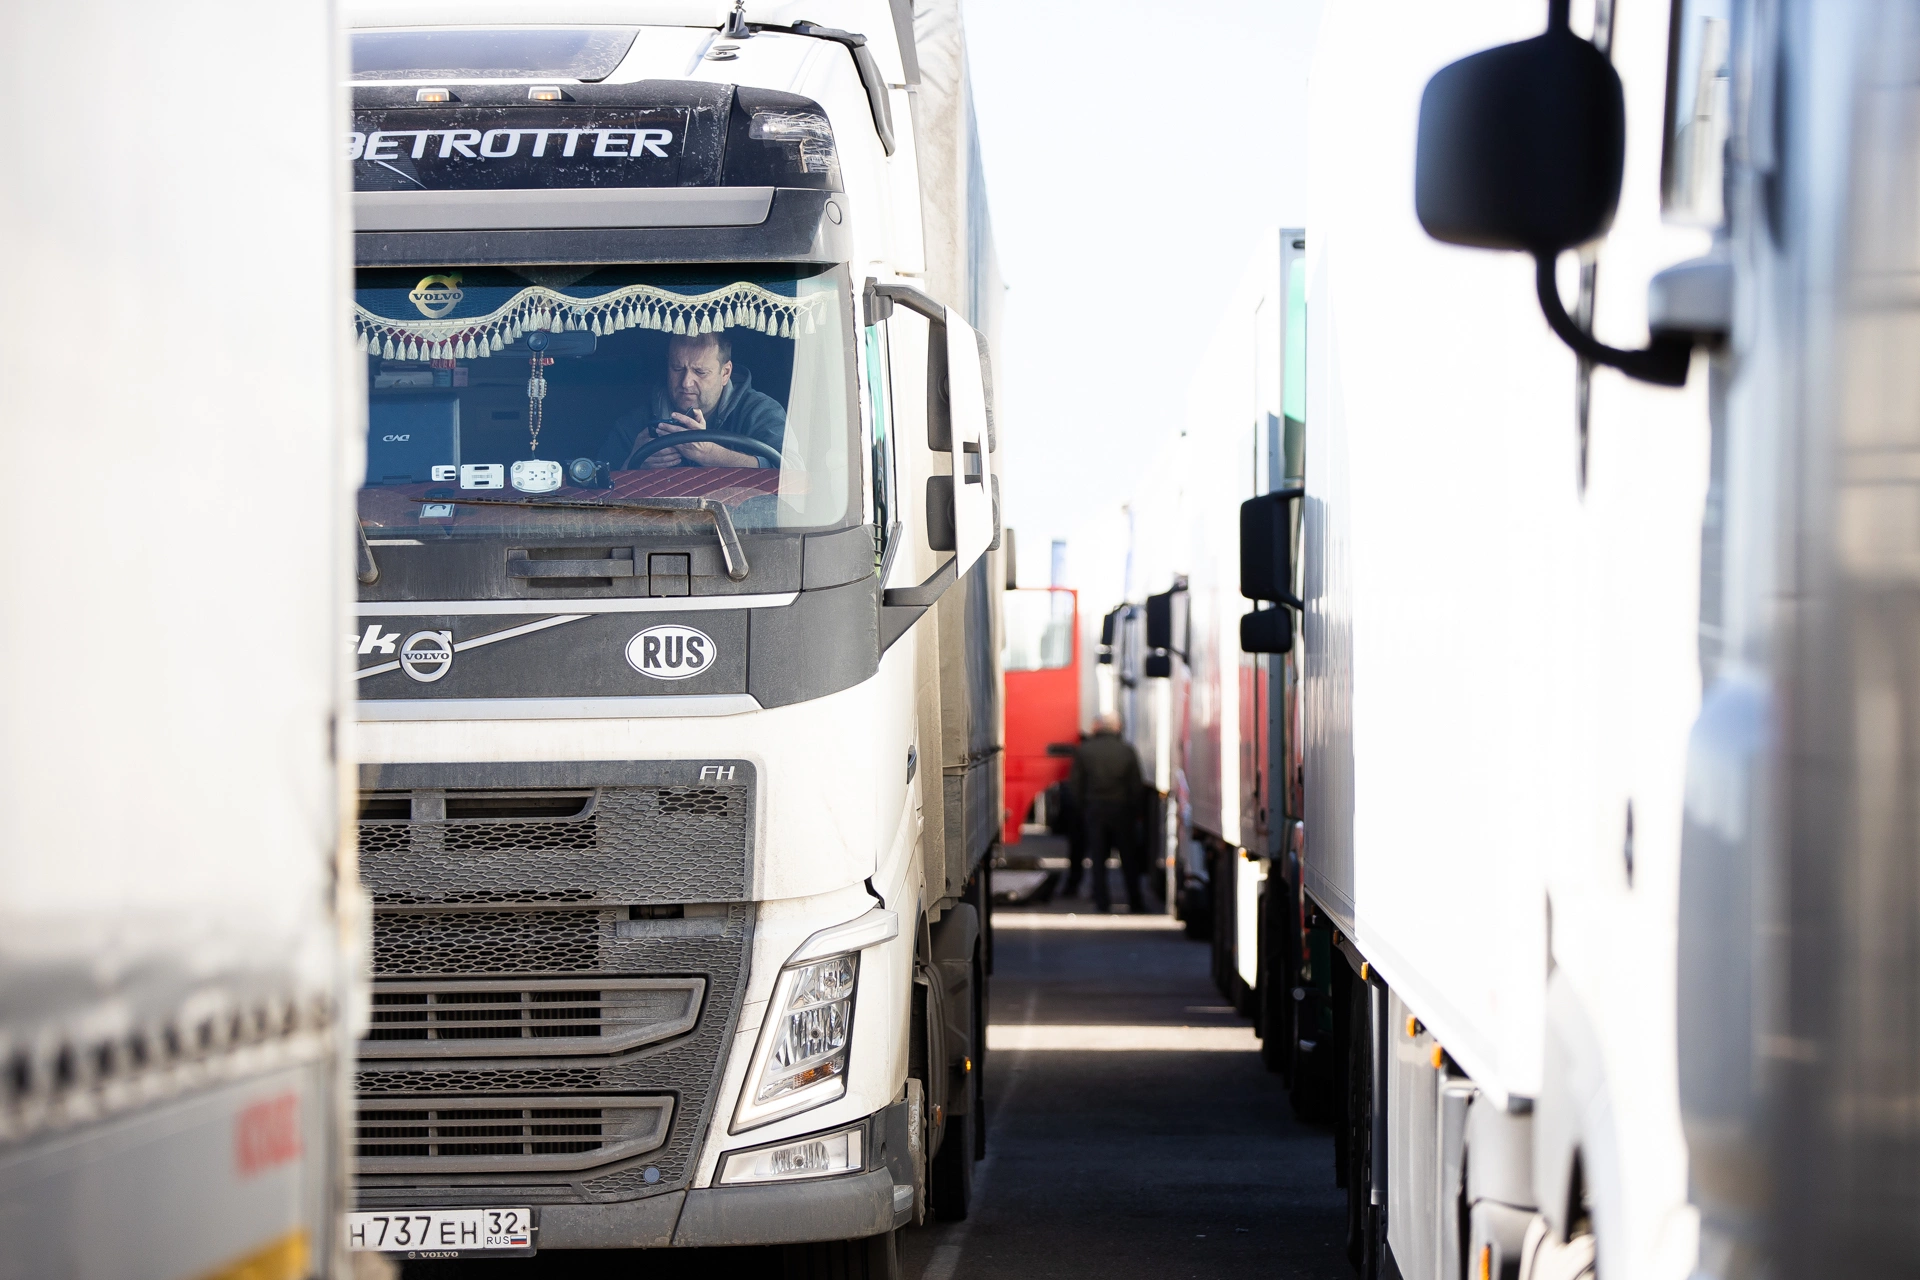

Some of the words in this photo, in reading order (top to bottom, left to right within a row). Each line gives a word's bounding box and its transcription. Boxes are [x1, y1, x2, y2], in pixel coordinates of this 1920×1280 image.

[413, 292, 462, 301] VOLVO
[403, 652, 450, 661] VOLVO
[643, 635, 705, 669] RUS
[699, 765, 736, 780] FH
[489, 1212, 519, 1235] 32
[486, 1235, 510, 1245] RUS
